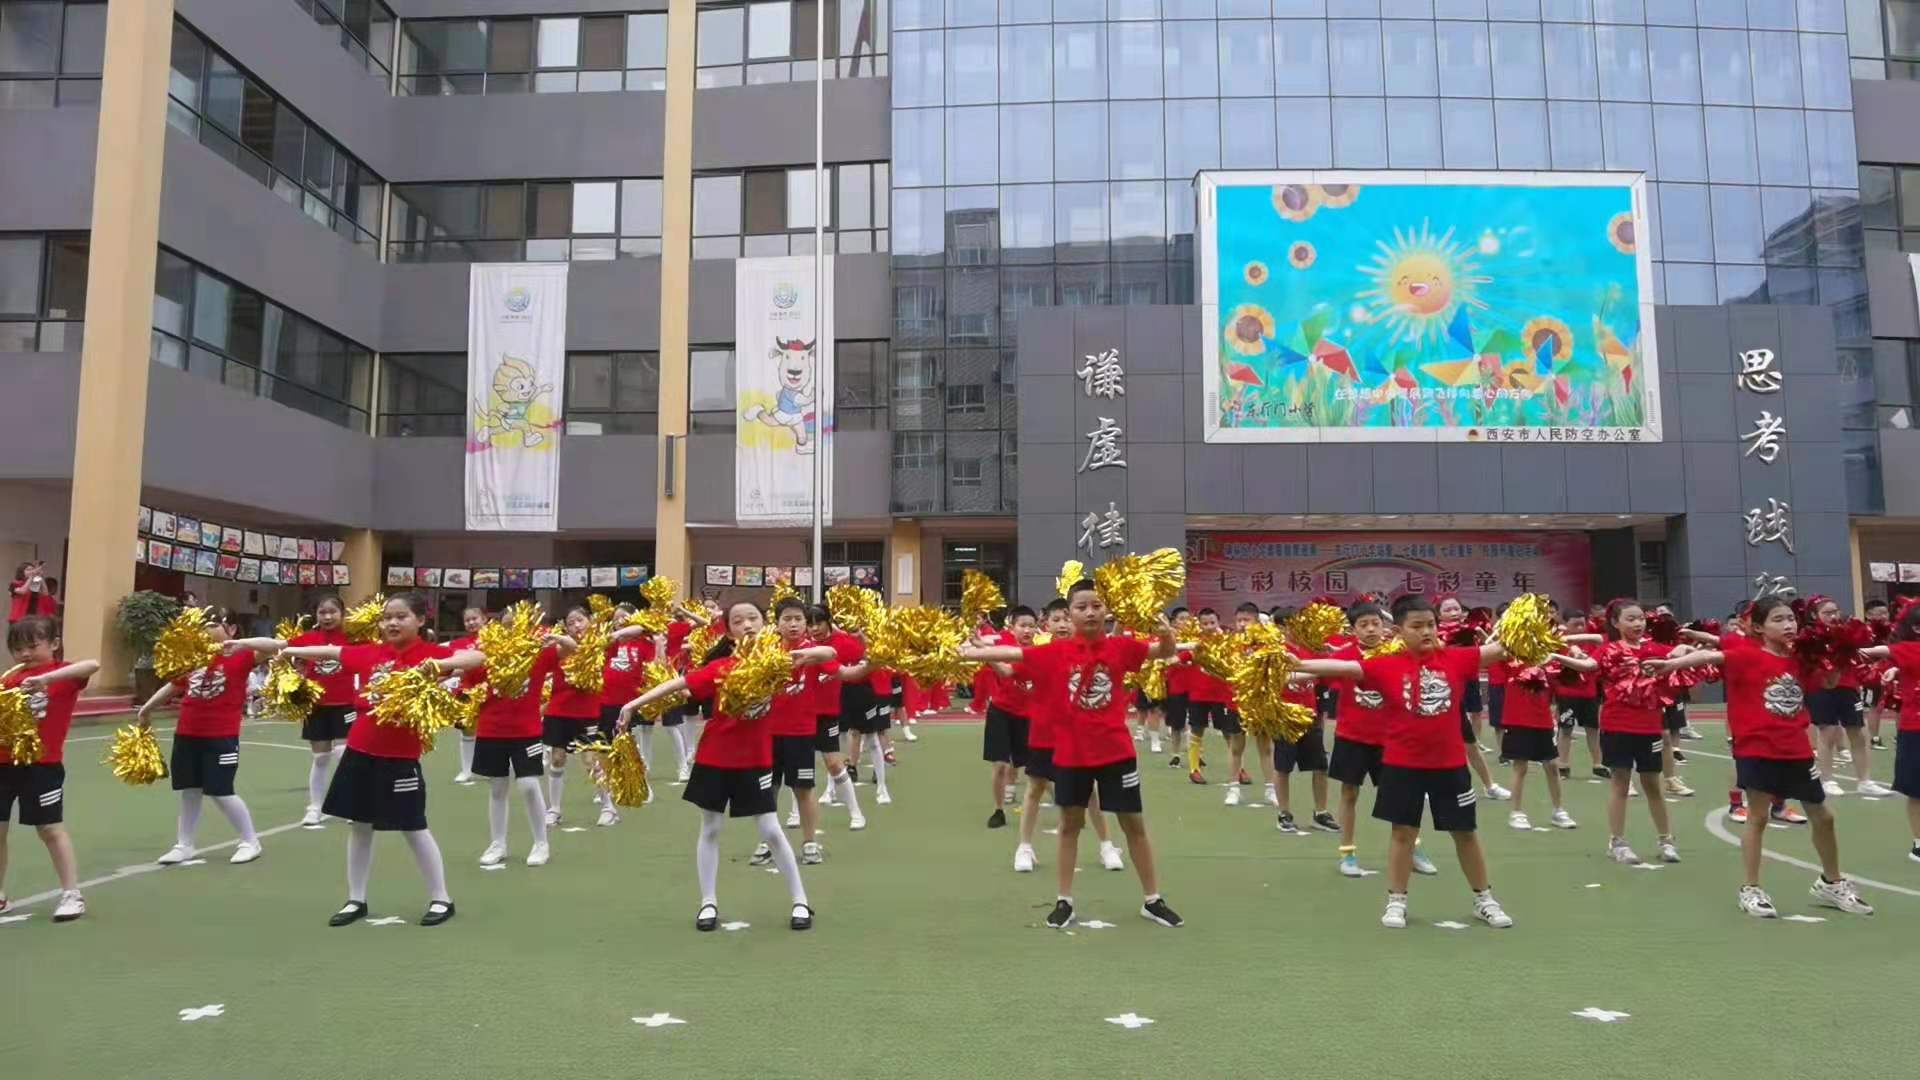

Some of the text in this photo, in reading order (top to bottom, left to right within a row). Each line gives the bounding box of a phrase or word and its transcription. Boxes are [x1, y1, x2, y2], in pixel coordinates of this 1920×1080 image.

[1486, 428, 1642, 441] 西安市人民防空办公室
[1217, 570, 1537, 593] 七彩校园 七彩童年
